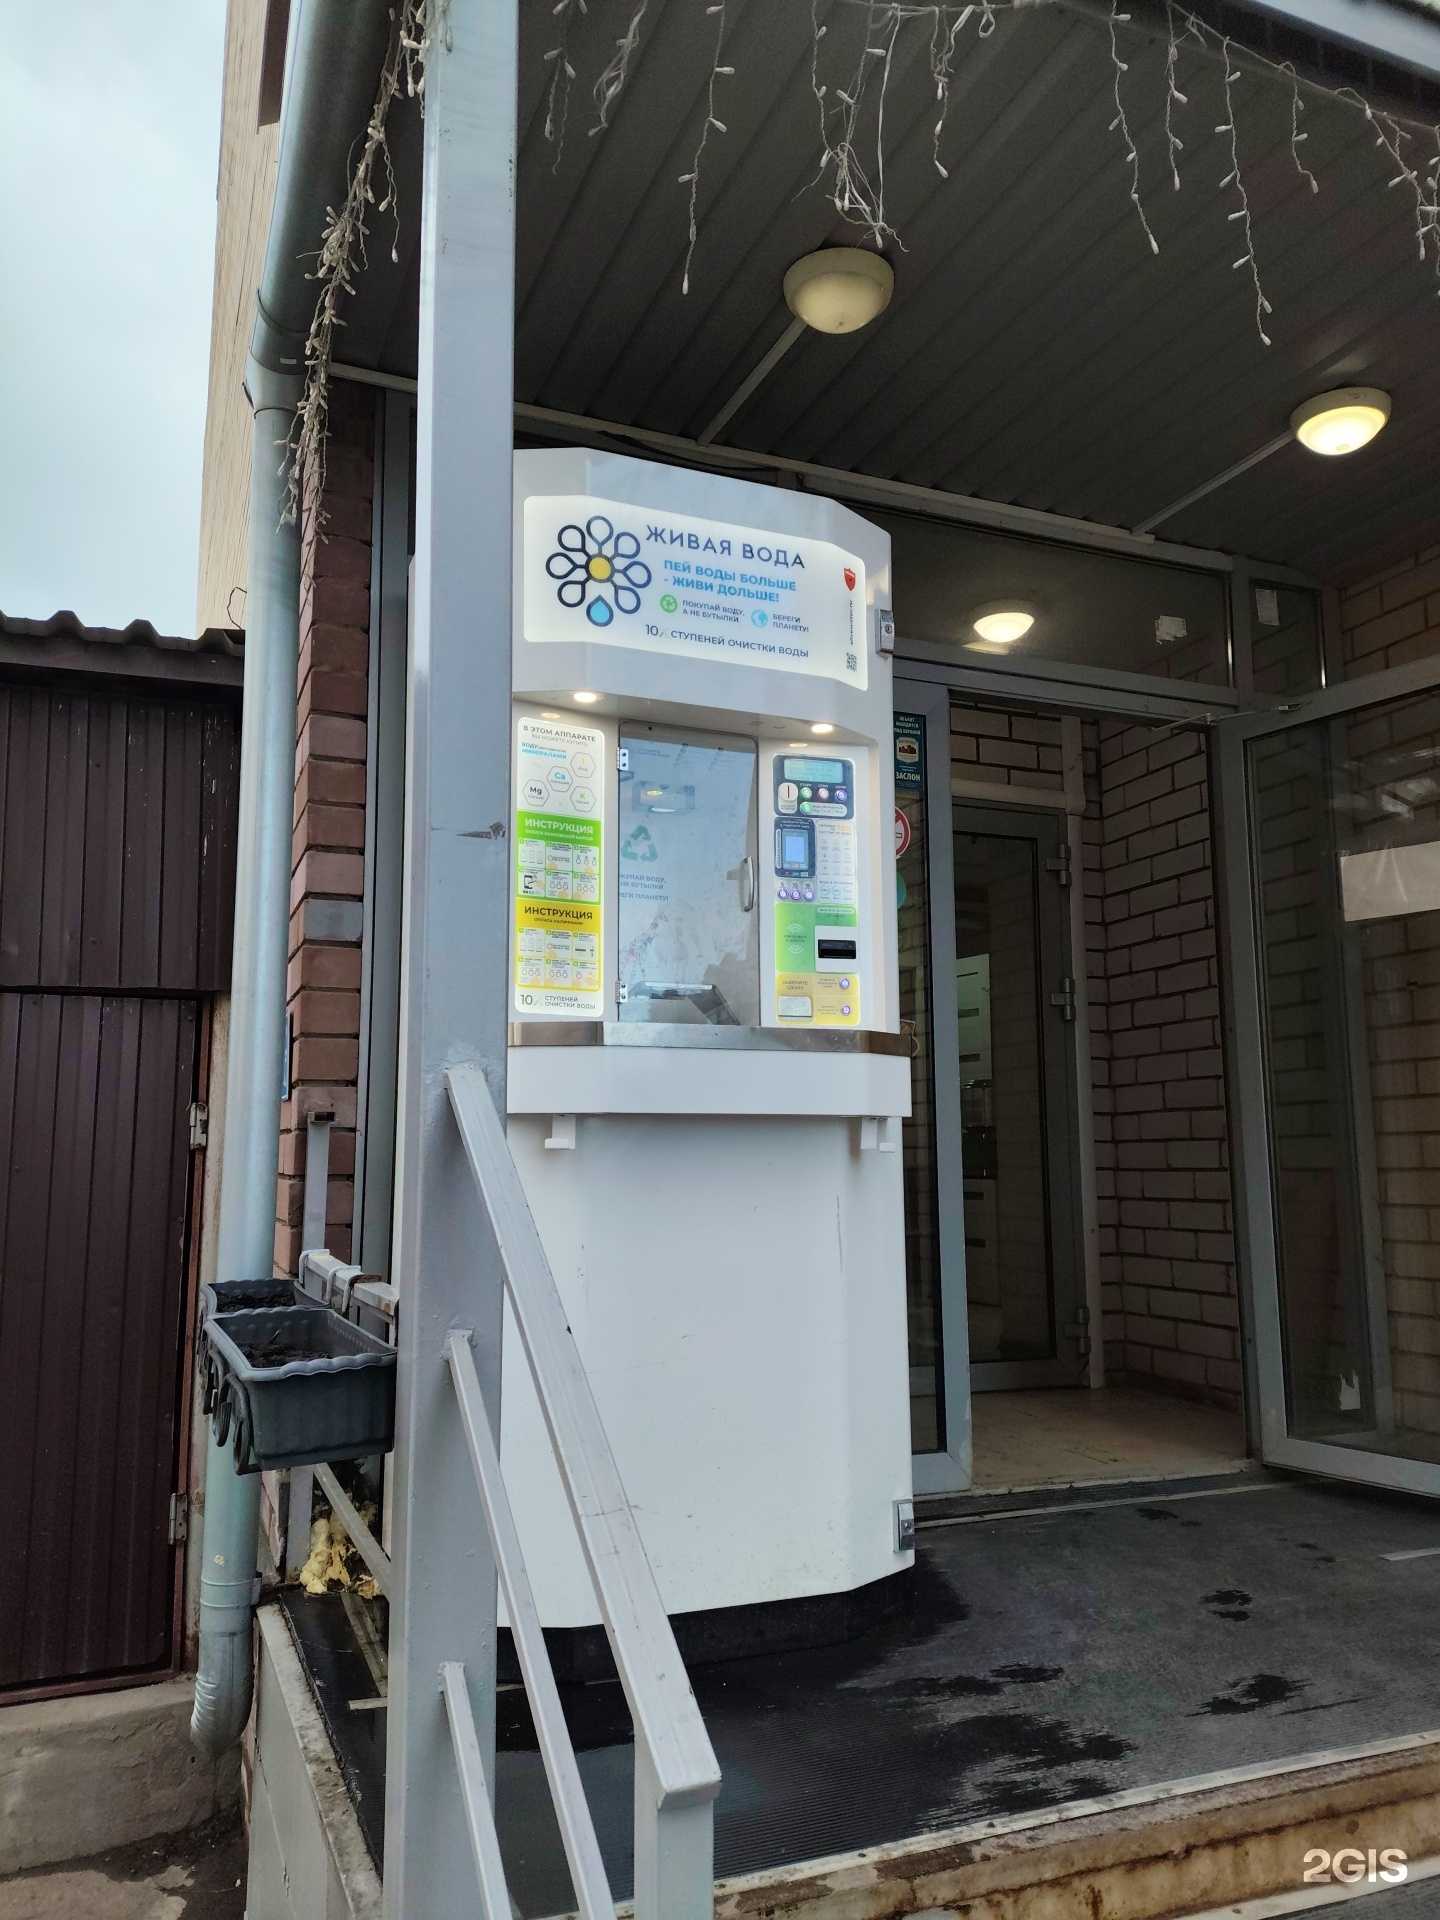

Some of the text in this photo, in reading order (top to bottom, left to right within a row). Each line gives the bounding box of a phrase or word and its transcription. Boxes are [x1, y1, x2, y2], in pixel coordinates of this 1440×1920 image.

[646, 524, 806, 569] ЖИВАЯ ВОДА
[664, 559, 798, 592] ПЕЙ ВОДЫ БОЛЬШЕ
[672, 575, 714, 592] ЖИВИ
[716, 581, 780, 603] ДОЛЬШЕ!
[682, 599, 721, 611] ПОКУПАЙ
[702, 612, 739, 623] БУТЫЛКИ
[772, 613, 801, 624] БЕРЕГИ
[671, 629, 725, 646] СТУПЕНЕЙ
[727, 638, 777, 654] ОЧИСТКИ
[778, 646, 809, 658] ВОДЫ
[530, 726, 553, 735] ЭТОМ
[554, 730, 596, 742] АППАРАТЕ
[554, 771, 566, 780] Ca
[895, 771, 920, 782] ЗАСЛОН
[529, 786, 543, 796] Mg
[524, 817, 593, 834] ИНСТРУКЦИЯ
[524, 906, 593, 920] ИНСТРУКЦИЯ
[520, 994, 533, 1005] 10
